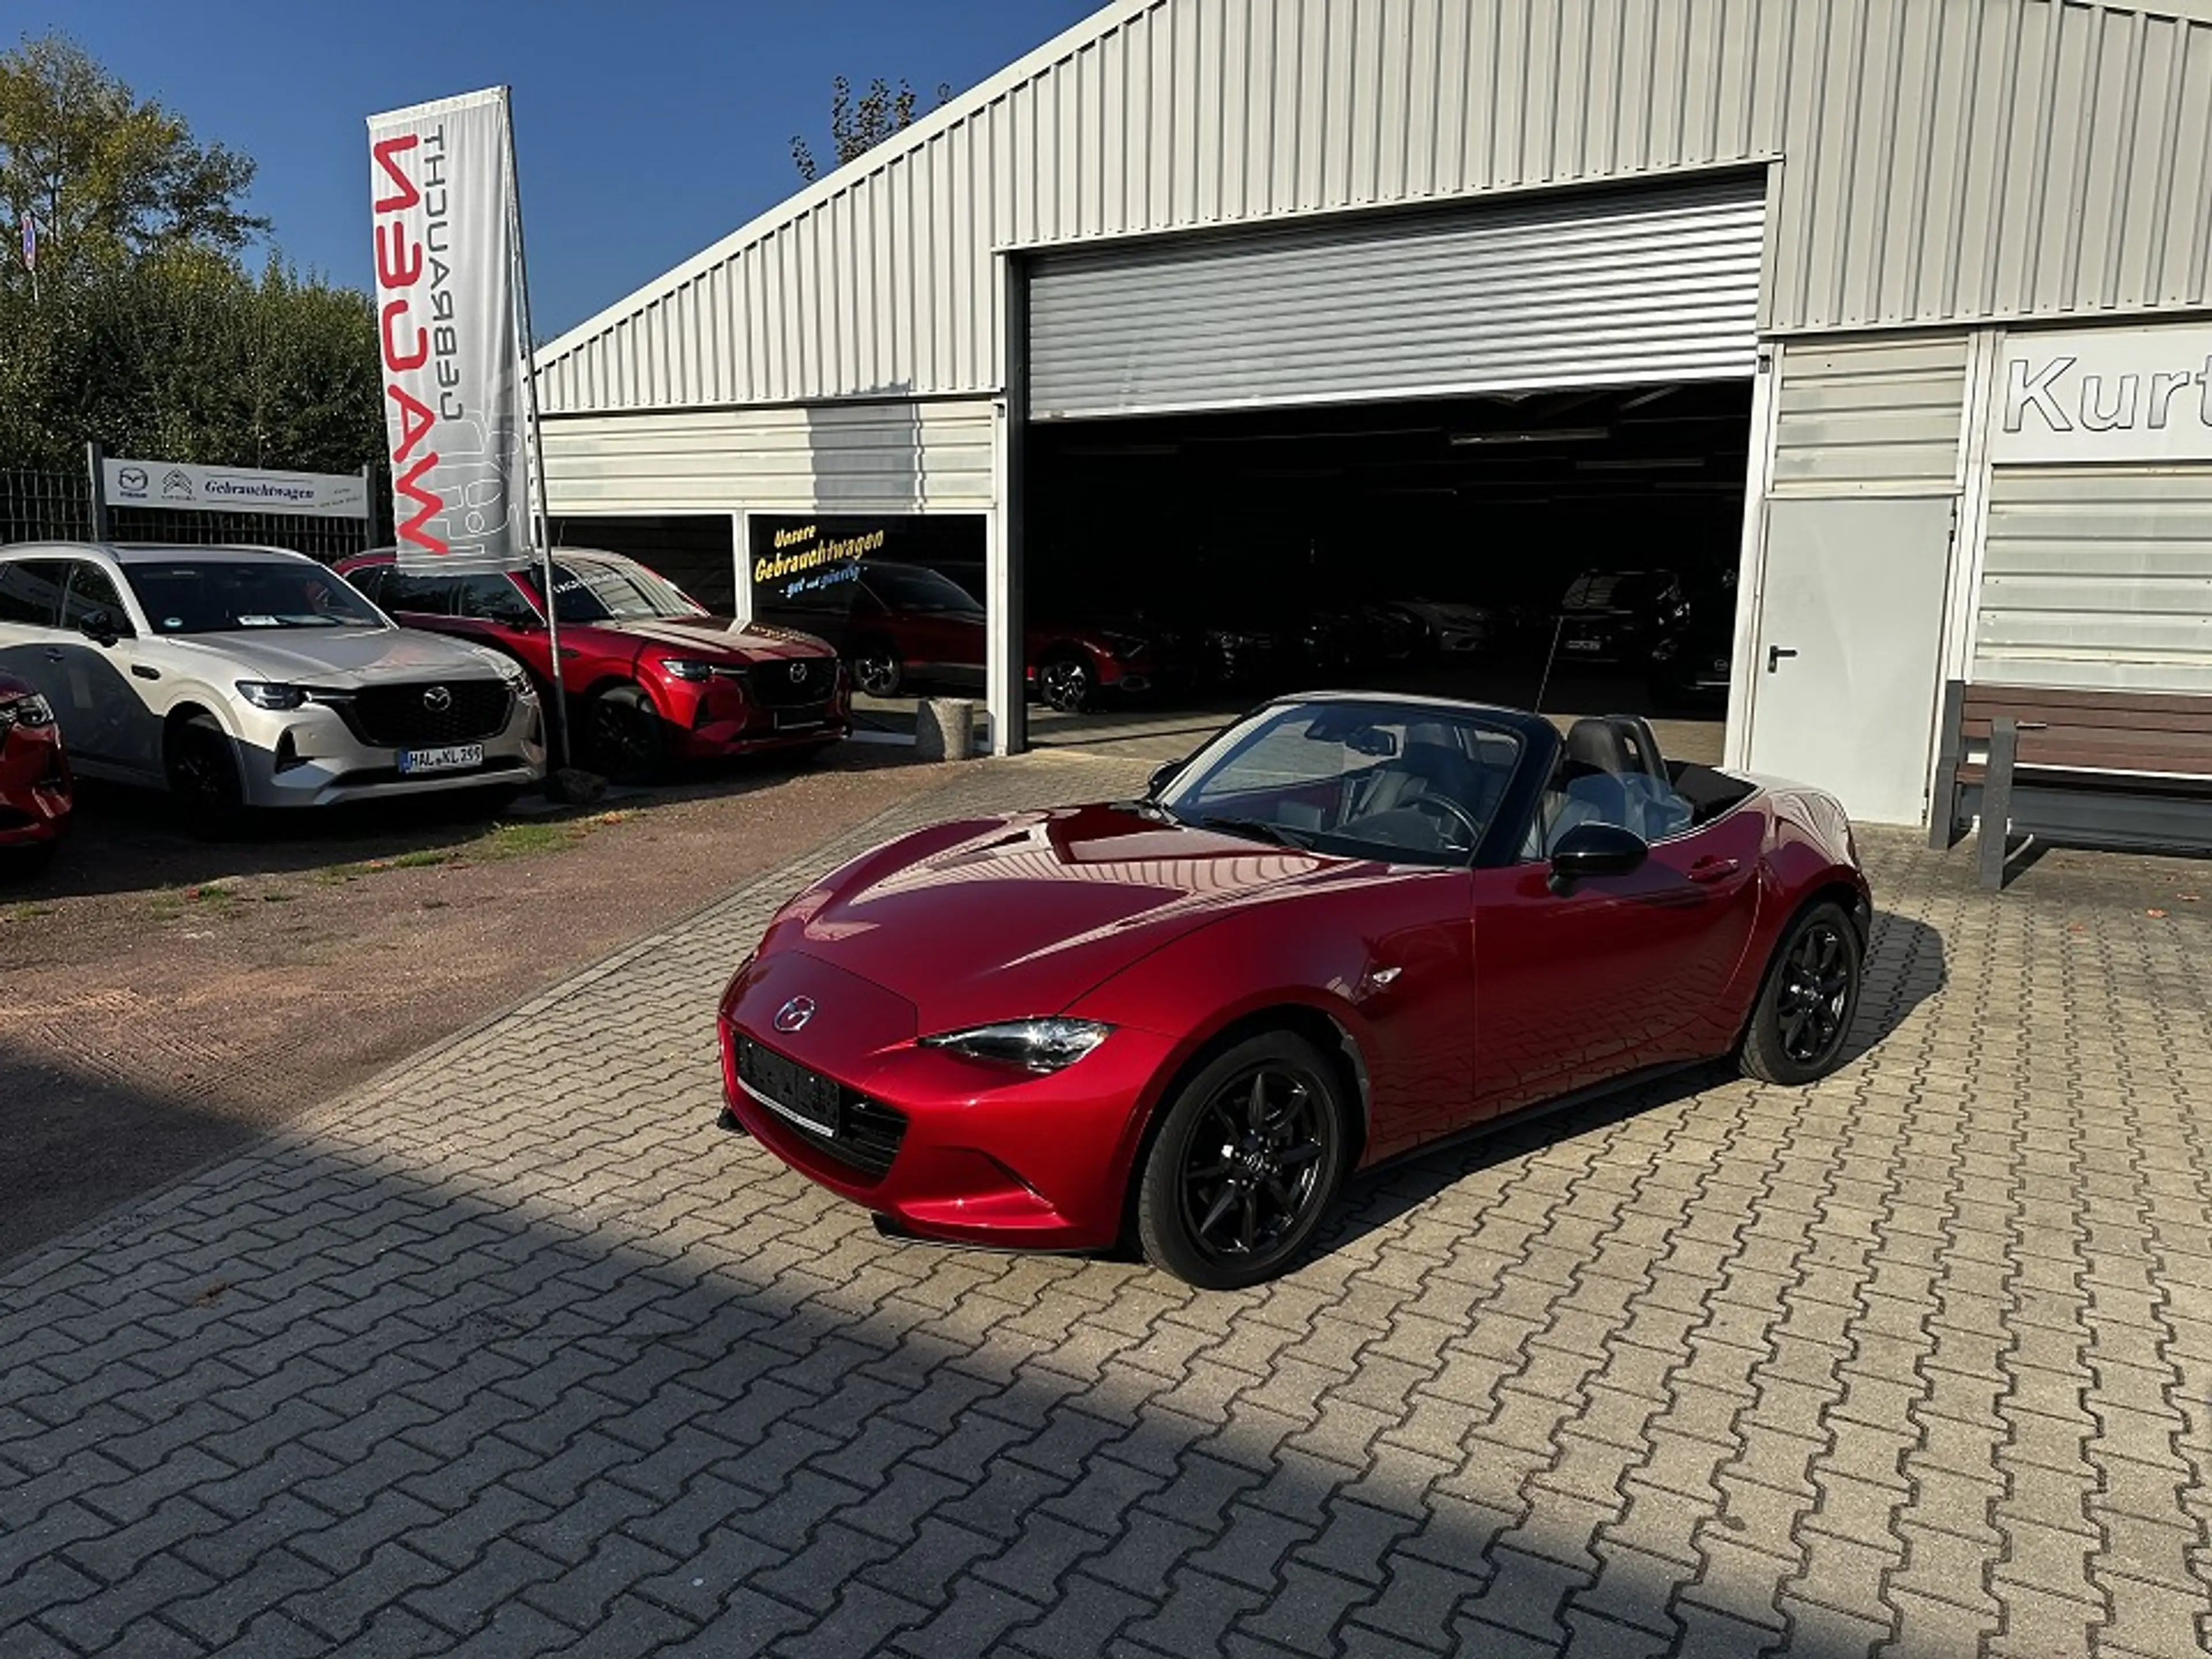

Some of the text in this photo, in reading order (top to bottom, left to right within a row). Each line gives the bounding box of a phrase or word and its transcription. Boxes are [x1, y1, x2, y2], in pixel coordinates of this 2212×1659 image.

[204, 480, 315, 500] Gebrauchtwagen
[774, 525, 816, 548] Unsere
[755, 529, 884, 583] Gebrauchtwagen
